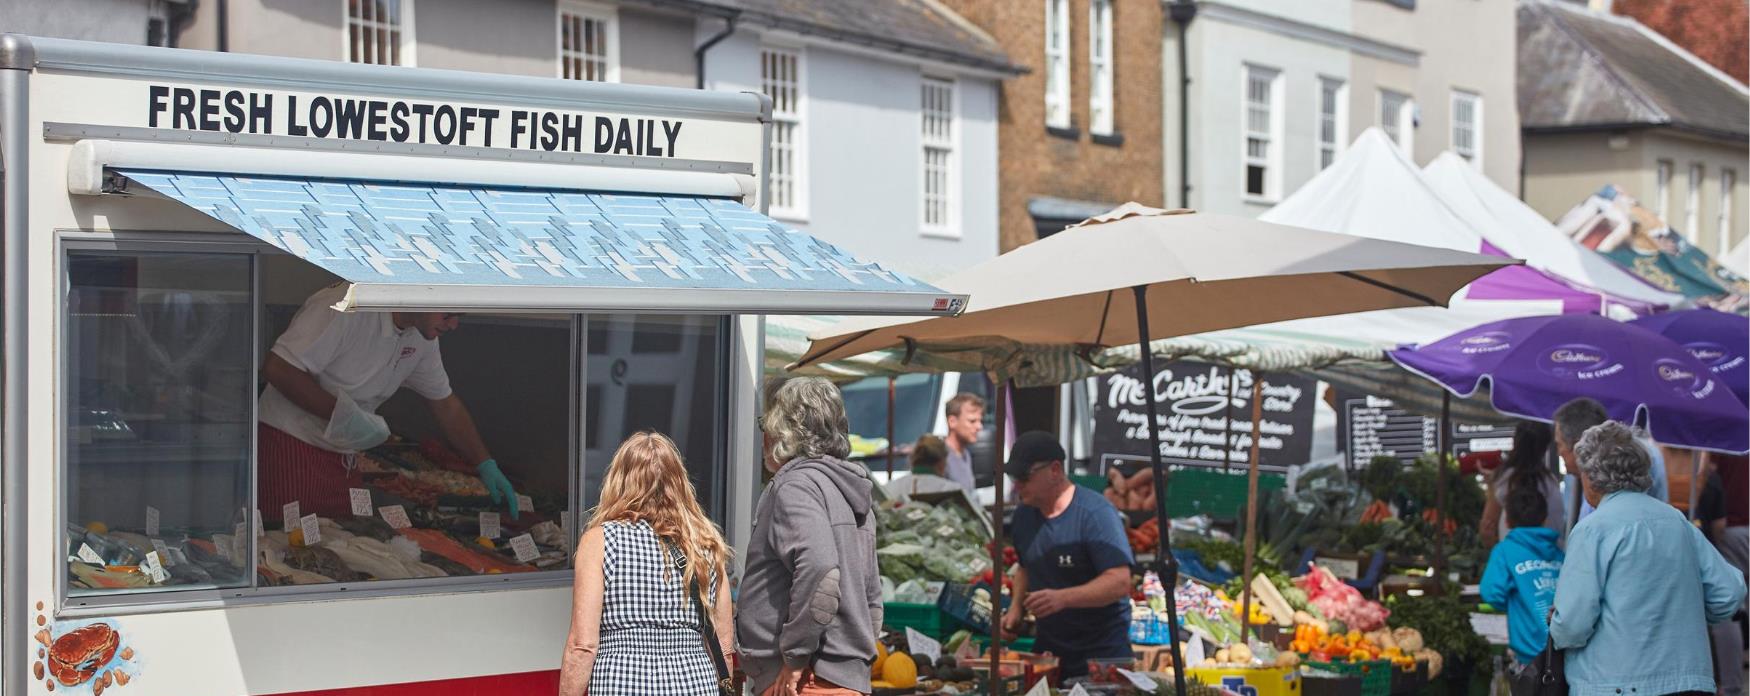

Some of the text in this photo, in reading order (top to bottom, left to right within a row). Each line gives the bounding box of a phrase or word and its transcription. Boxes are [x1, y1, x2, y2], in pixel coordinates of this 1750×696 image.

[149, 85, 683, 158] FRESH LOWESTOFT FISH DAILY
[1551, 350, 1600, 363] Cadbury
[1594, 363, 1624, 378] cream
